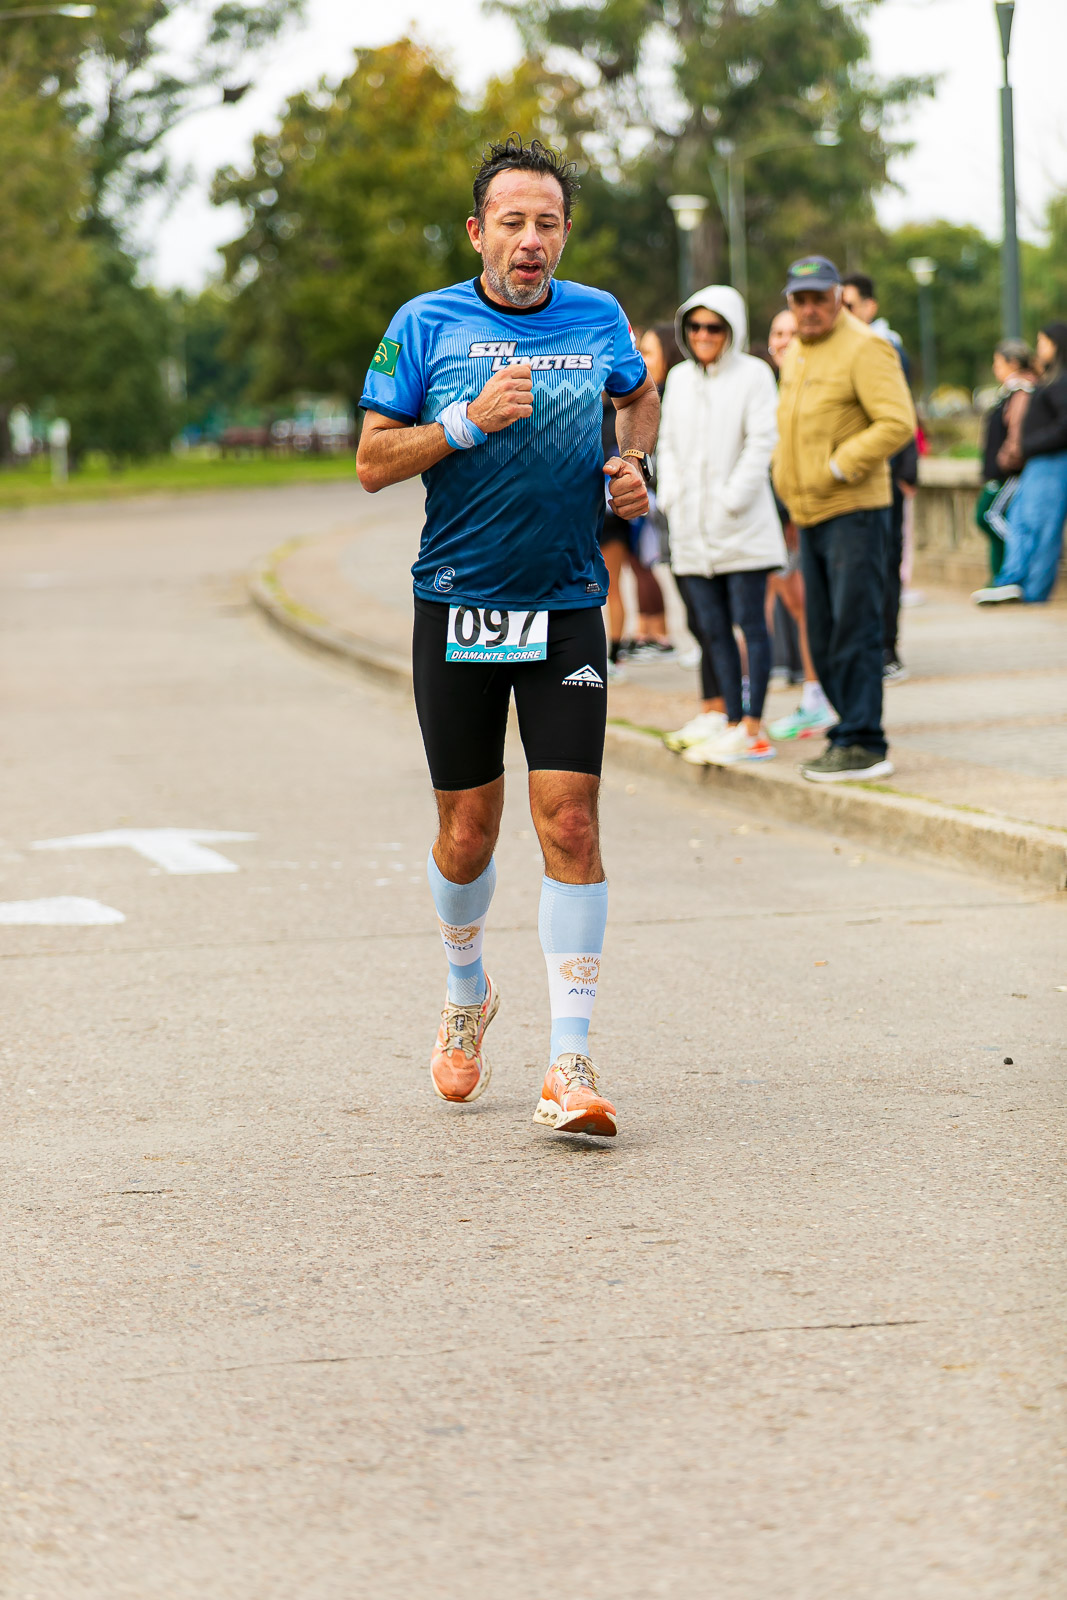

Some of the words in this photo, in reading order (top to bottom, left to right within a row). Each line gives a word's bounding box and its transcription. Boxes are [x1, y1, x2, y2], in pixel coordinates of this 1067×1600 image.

[468, 341, 518, 358] SIN
[491, 354, 593, 371] LIMITES
[454, 605, 539, 649] 097
[450, 650, 505, 661] DIAMANTE
[506, 650, 542, 660] CORRE
[585, 681, 604, 689] TRAIL
[444, 941, 474, 951] ARG
[568, 988, 596, 997] ARG
